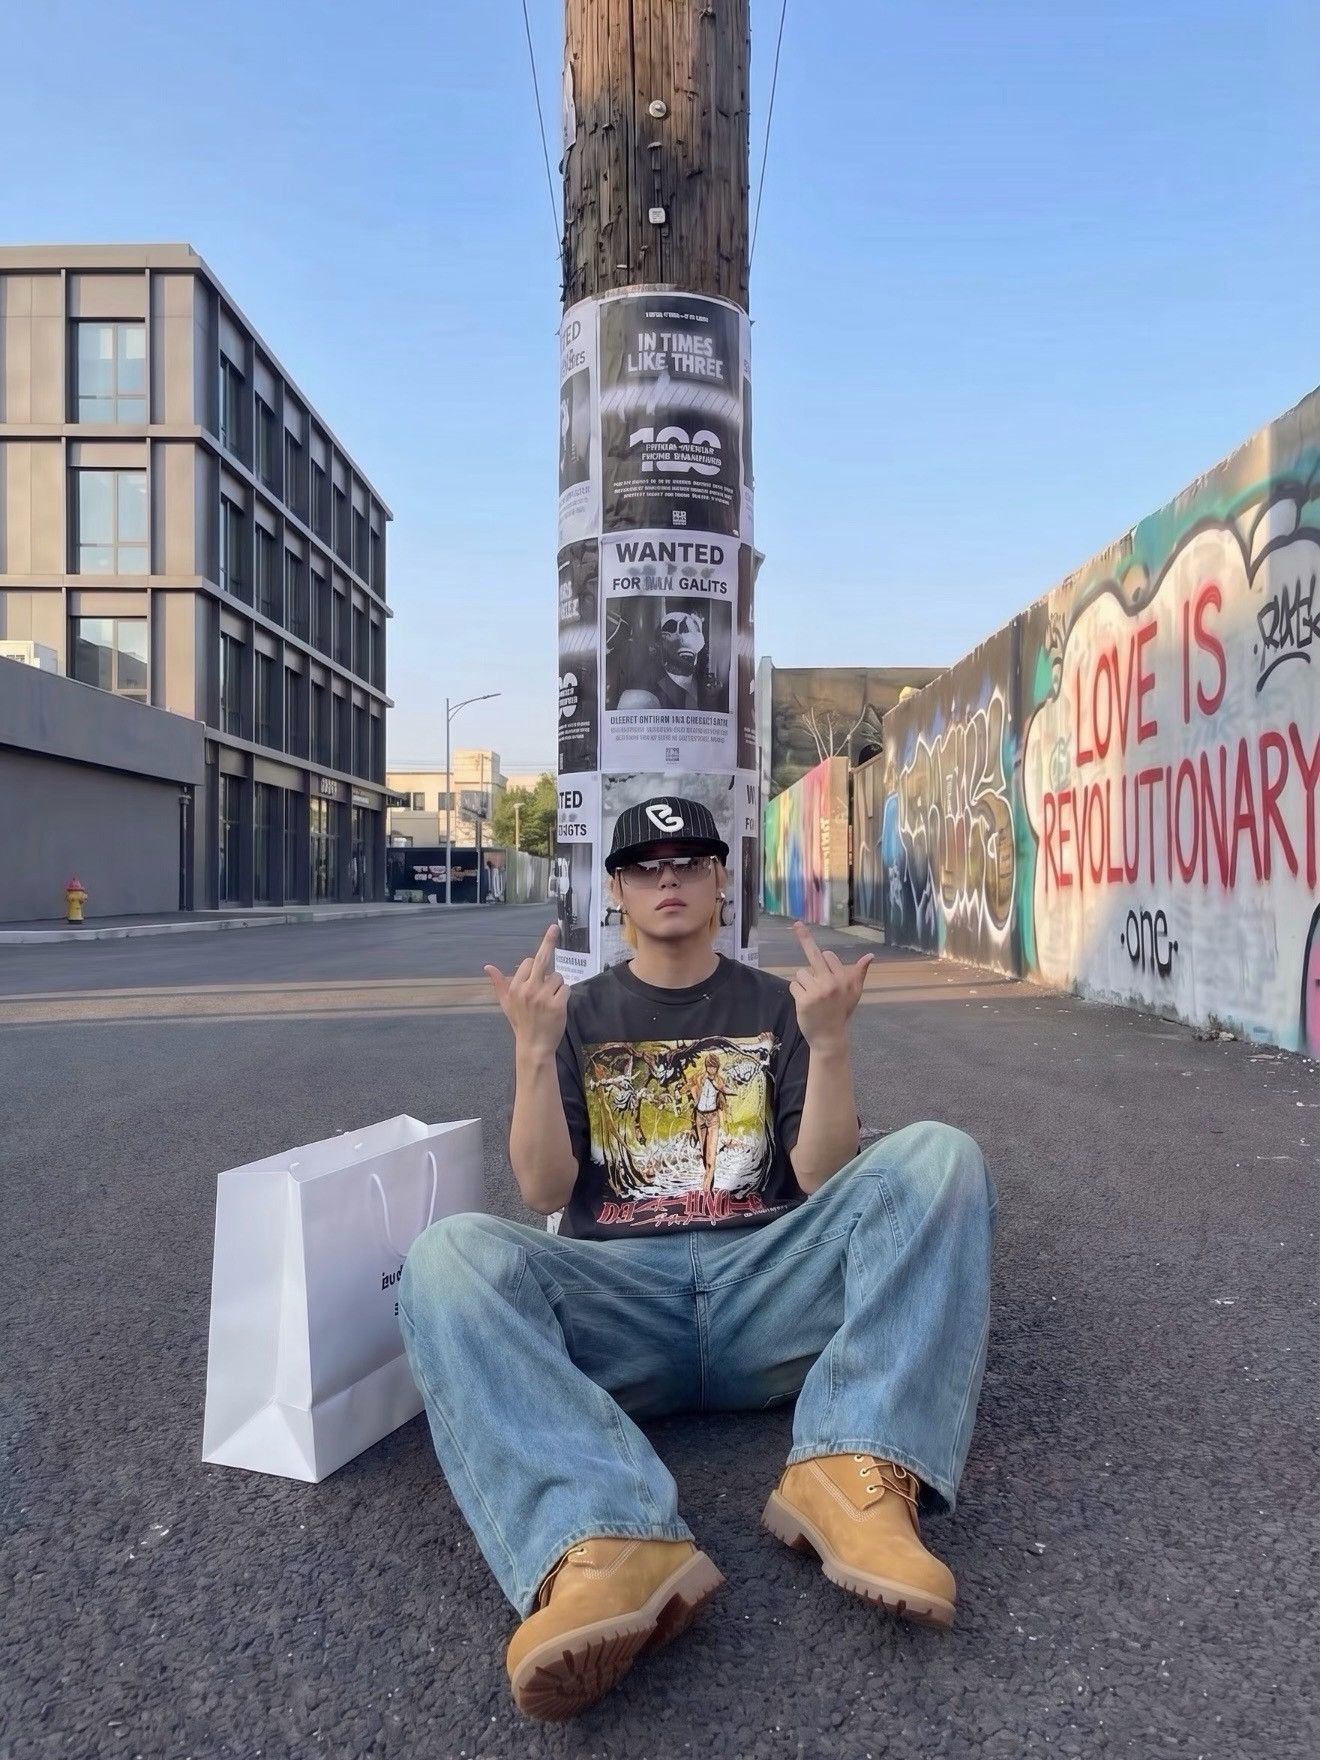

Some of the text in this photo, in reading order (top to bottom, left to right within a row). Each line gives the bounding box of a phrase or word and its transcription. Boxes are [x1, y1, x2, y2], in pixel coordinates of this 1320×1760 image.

[638, 332, 713, 357] IN TIMES
[627, 352, 724, 380] LIKE THREE
[615, 541, 725, 566] WANTED
[612, 577, 641, 591] FOR
[678, 577, 728, 595] GALITS
[1075, 583, 1228, 768] LOVE IS
[1042, 721, 1320, 894] REVOLUTIONARY
